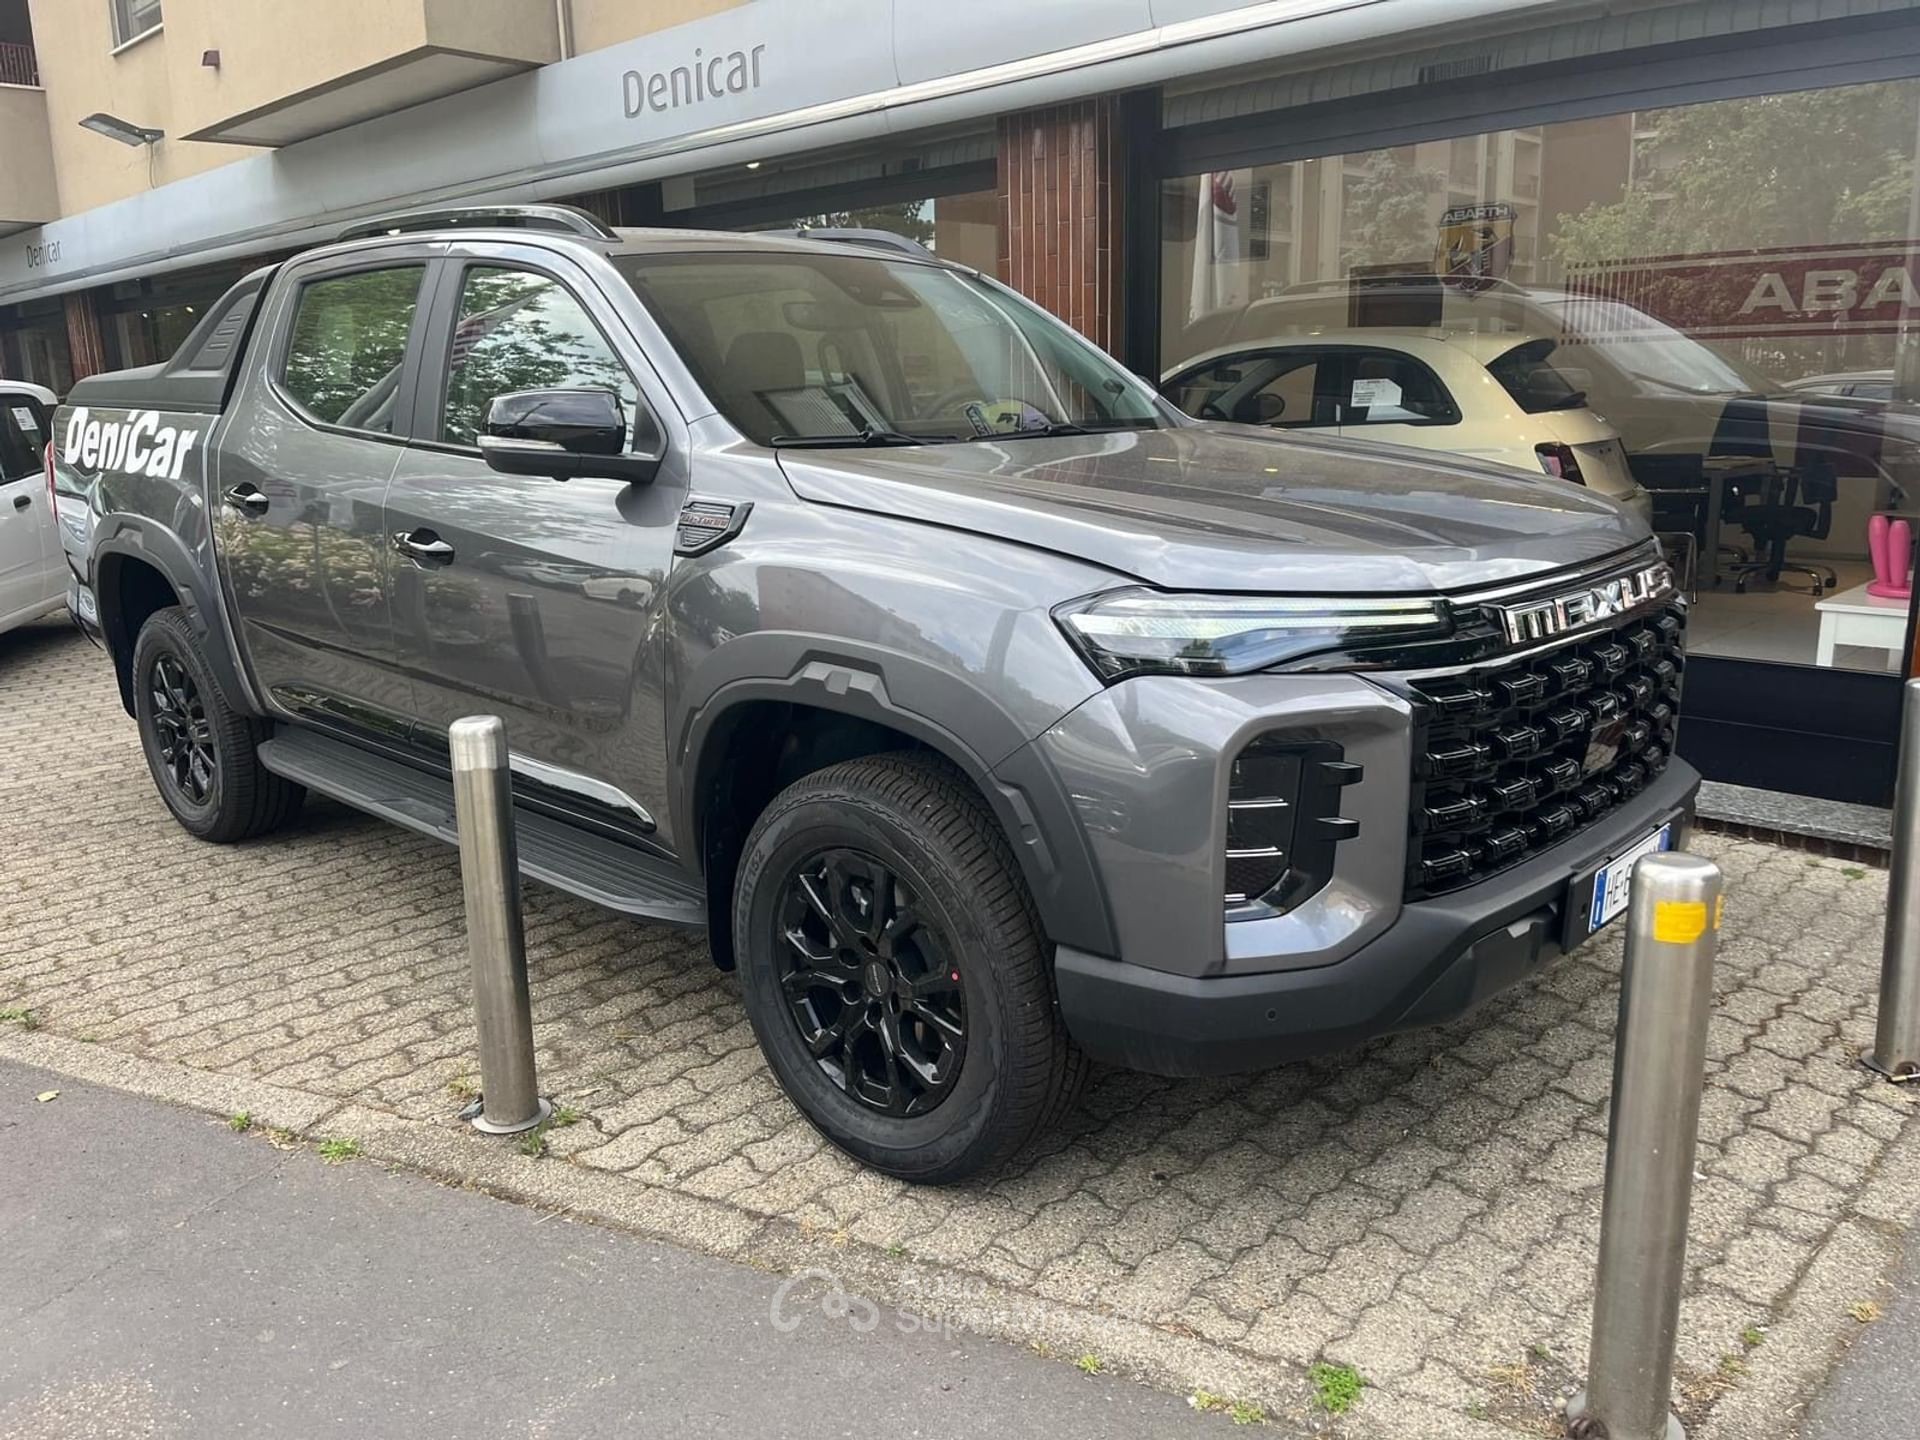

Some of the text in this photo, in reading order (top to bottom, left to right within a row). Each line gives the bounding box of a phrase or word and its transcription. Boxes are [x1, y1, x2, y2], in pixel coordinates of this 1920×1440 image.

[622, 43, 766, 119] Denicar
[1441, 207, 1509, 224] ABARTH
[26, 239, 62, 268] Denicar
[64, 406, 199, 480] DeniCar
